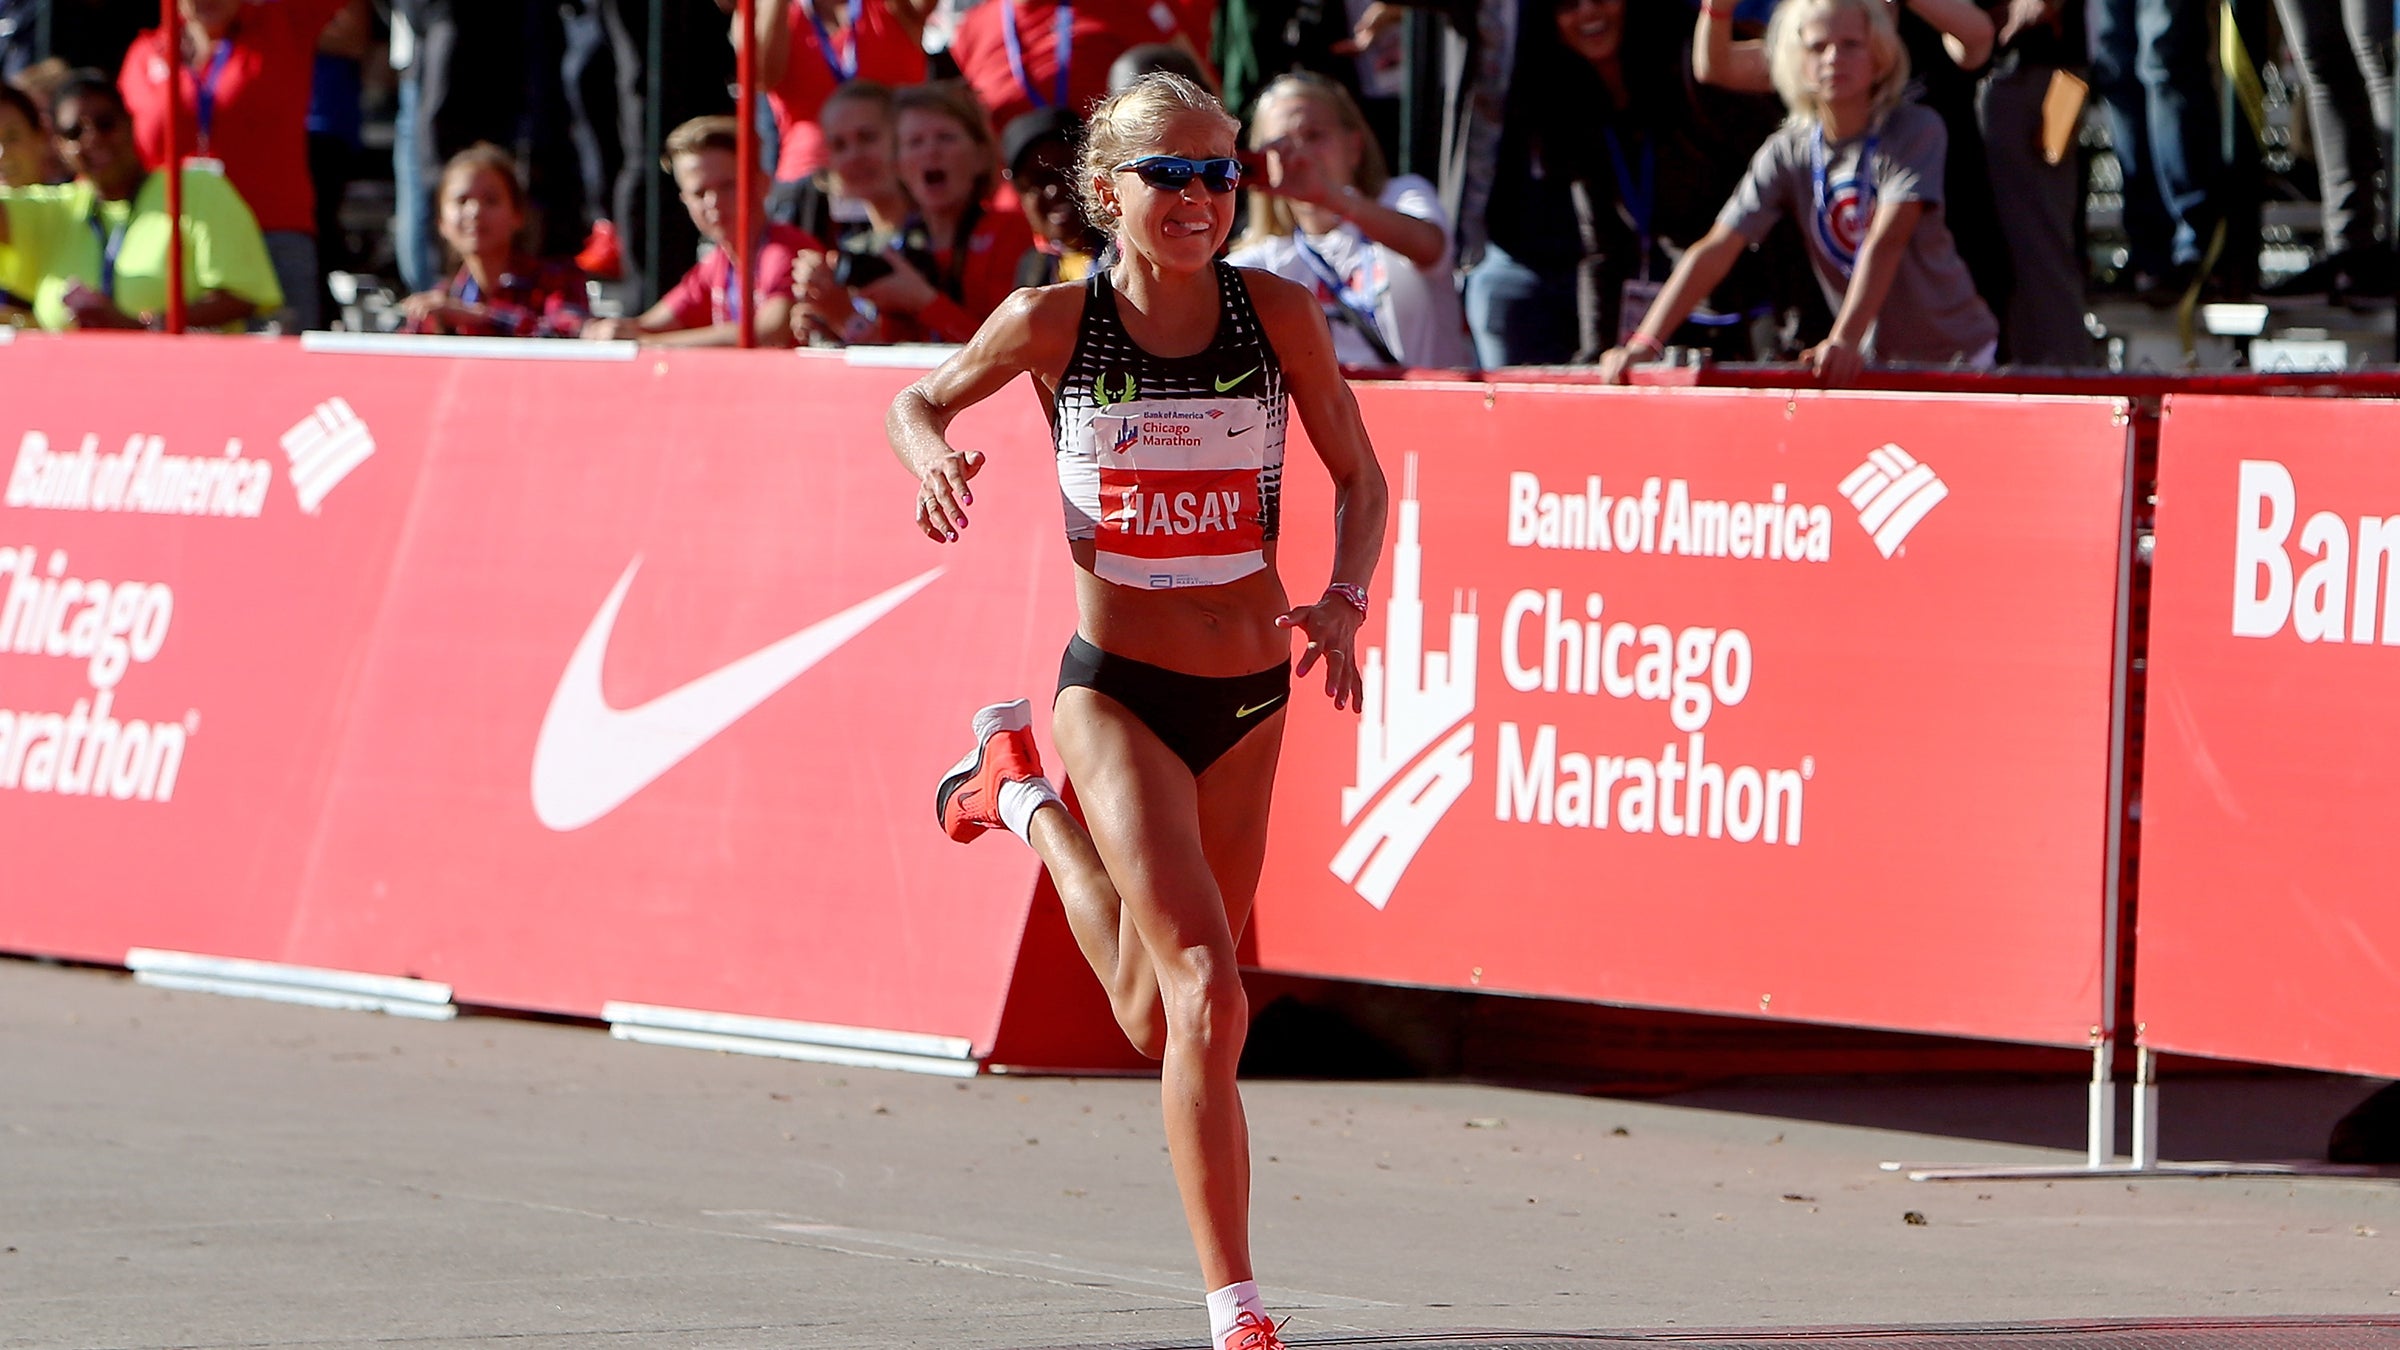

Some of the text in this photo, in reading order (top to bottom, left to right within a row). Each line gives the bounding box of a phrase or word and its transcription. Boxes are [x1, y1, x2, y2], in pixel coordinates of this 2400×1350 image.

[1143, 422, 1190, 436] Chicago
[1144, 411, 1204, 419] Bank of America
[1143, 435, 1200, 446] Marathon
[5, 430, 273, 518] Bank of America
[1120, 491, 1240, 535] HASAY
[1507, 471, 1832, 562] Bank of America
[1500, 588, 1753, 732] Chicago
